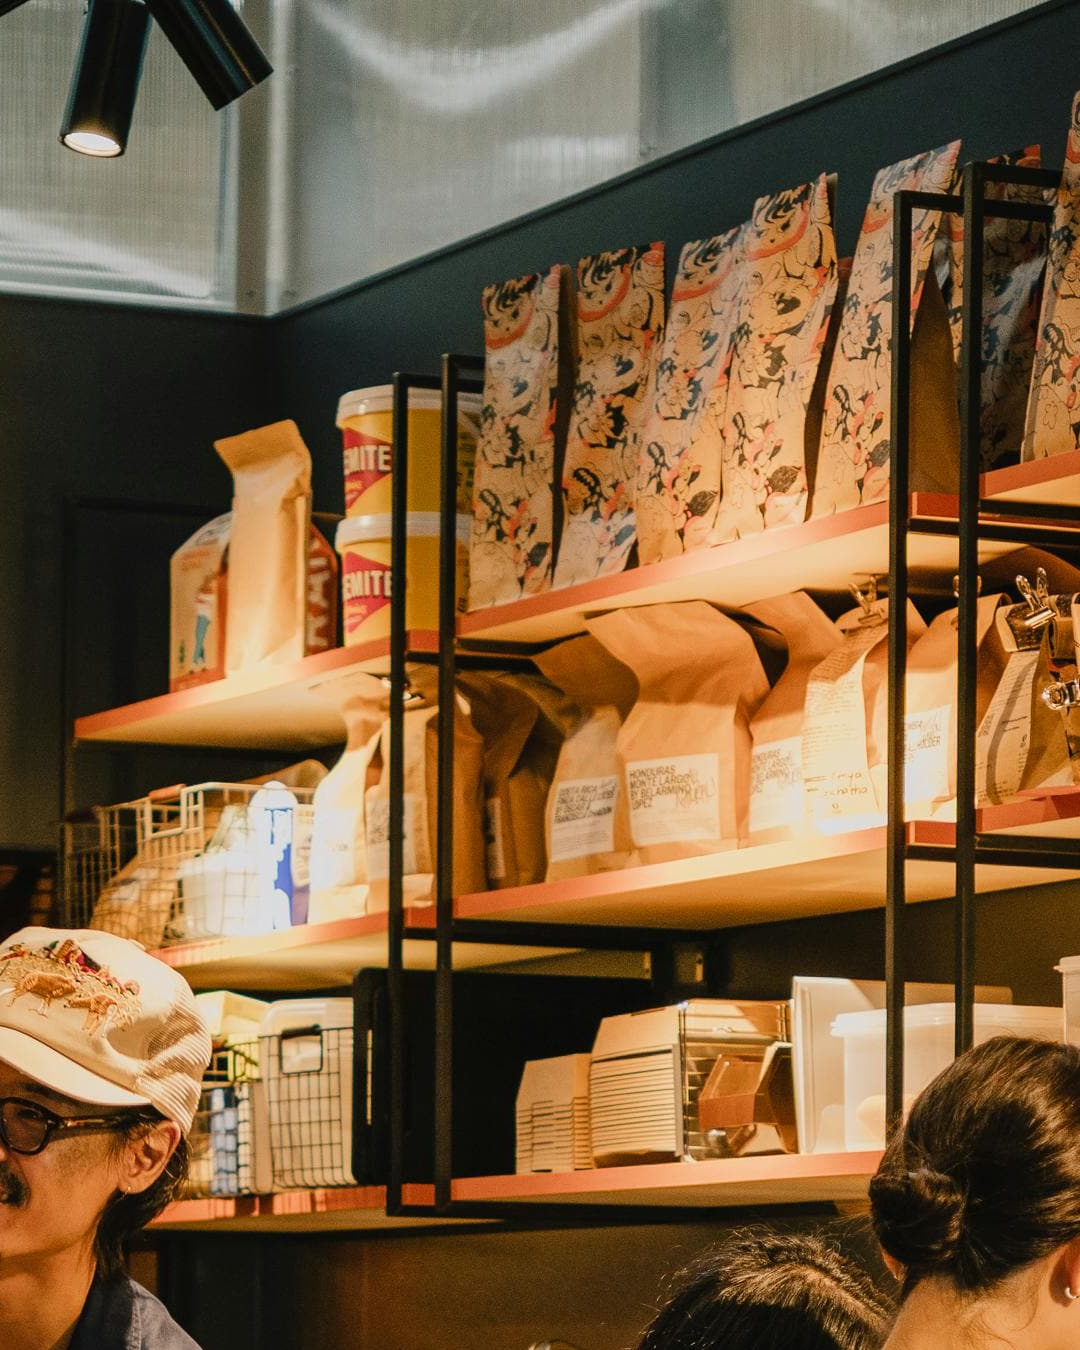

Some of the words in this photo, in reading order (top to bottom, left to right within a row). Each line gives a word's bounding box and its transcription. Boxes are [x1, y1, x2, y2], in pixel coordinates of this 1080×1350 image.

[629, 765, 676, 780] HONDURAS
[630, 778, 657, 789] MONTE
[660, 774, 692, 786] LARGO
[640, 784, 692, 800] BELARMINO
[632, 797, 653, 810] LOPEZ
